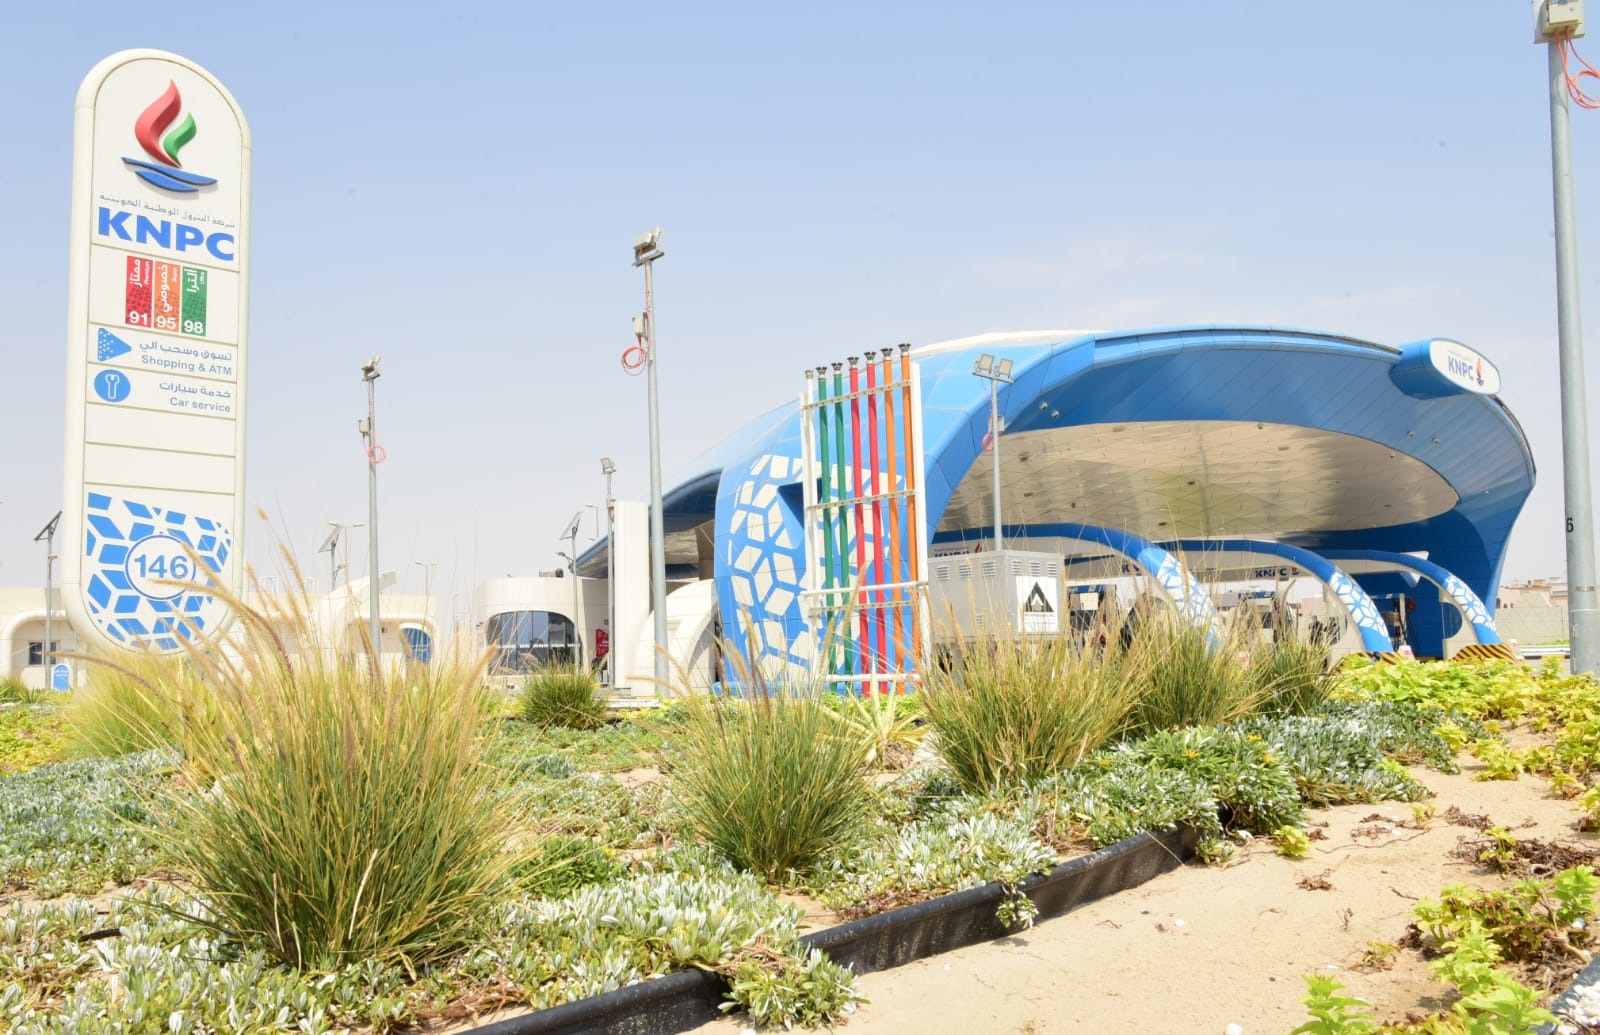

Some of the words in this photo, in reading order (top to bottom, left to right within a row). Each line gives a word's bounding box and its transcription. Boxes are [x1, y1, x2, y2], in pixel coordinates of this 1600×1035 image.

[98, 206, 235, 262] KNPC
[157, 264, 173, 313] خصوصي
[129, 310, 148, 326] 91
[156, 315, 177, 330] 95
[183, 320, 204, 334] 98
[201, 350, 232, 361] تسوق
[141, 354, 195, 372] Shopping
[198, 363, 206, 372] &
[209, 364, 232, 376] ATM
[1447, 355, 1474, 381] KNPC
[159, 382, 198, 394] سيارات
[170, 397, 189, 407] Car
[192, 401, 231, 412] service
[134, 554, 188, 579] 146
